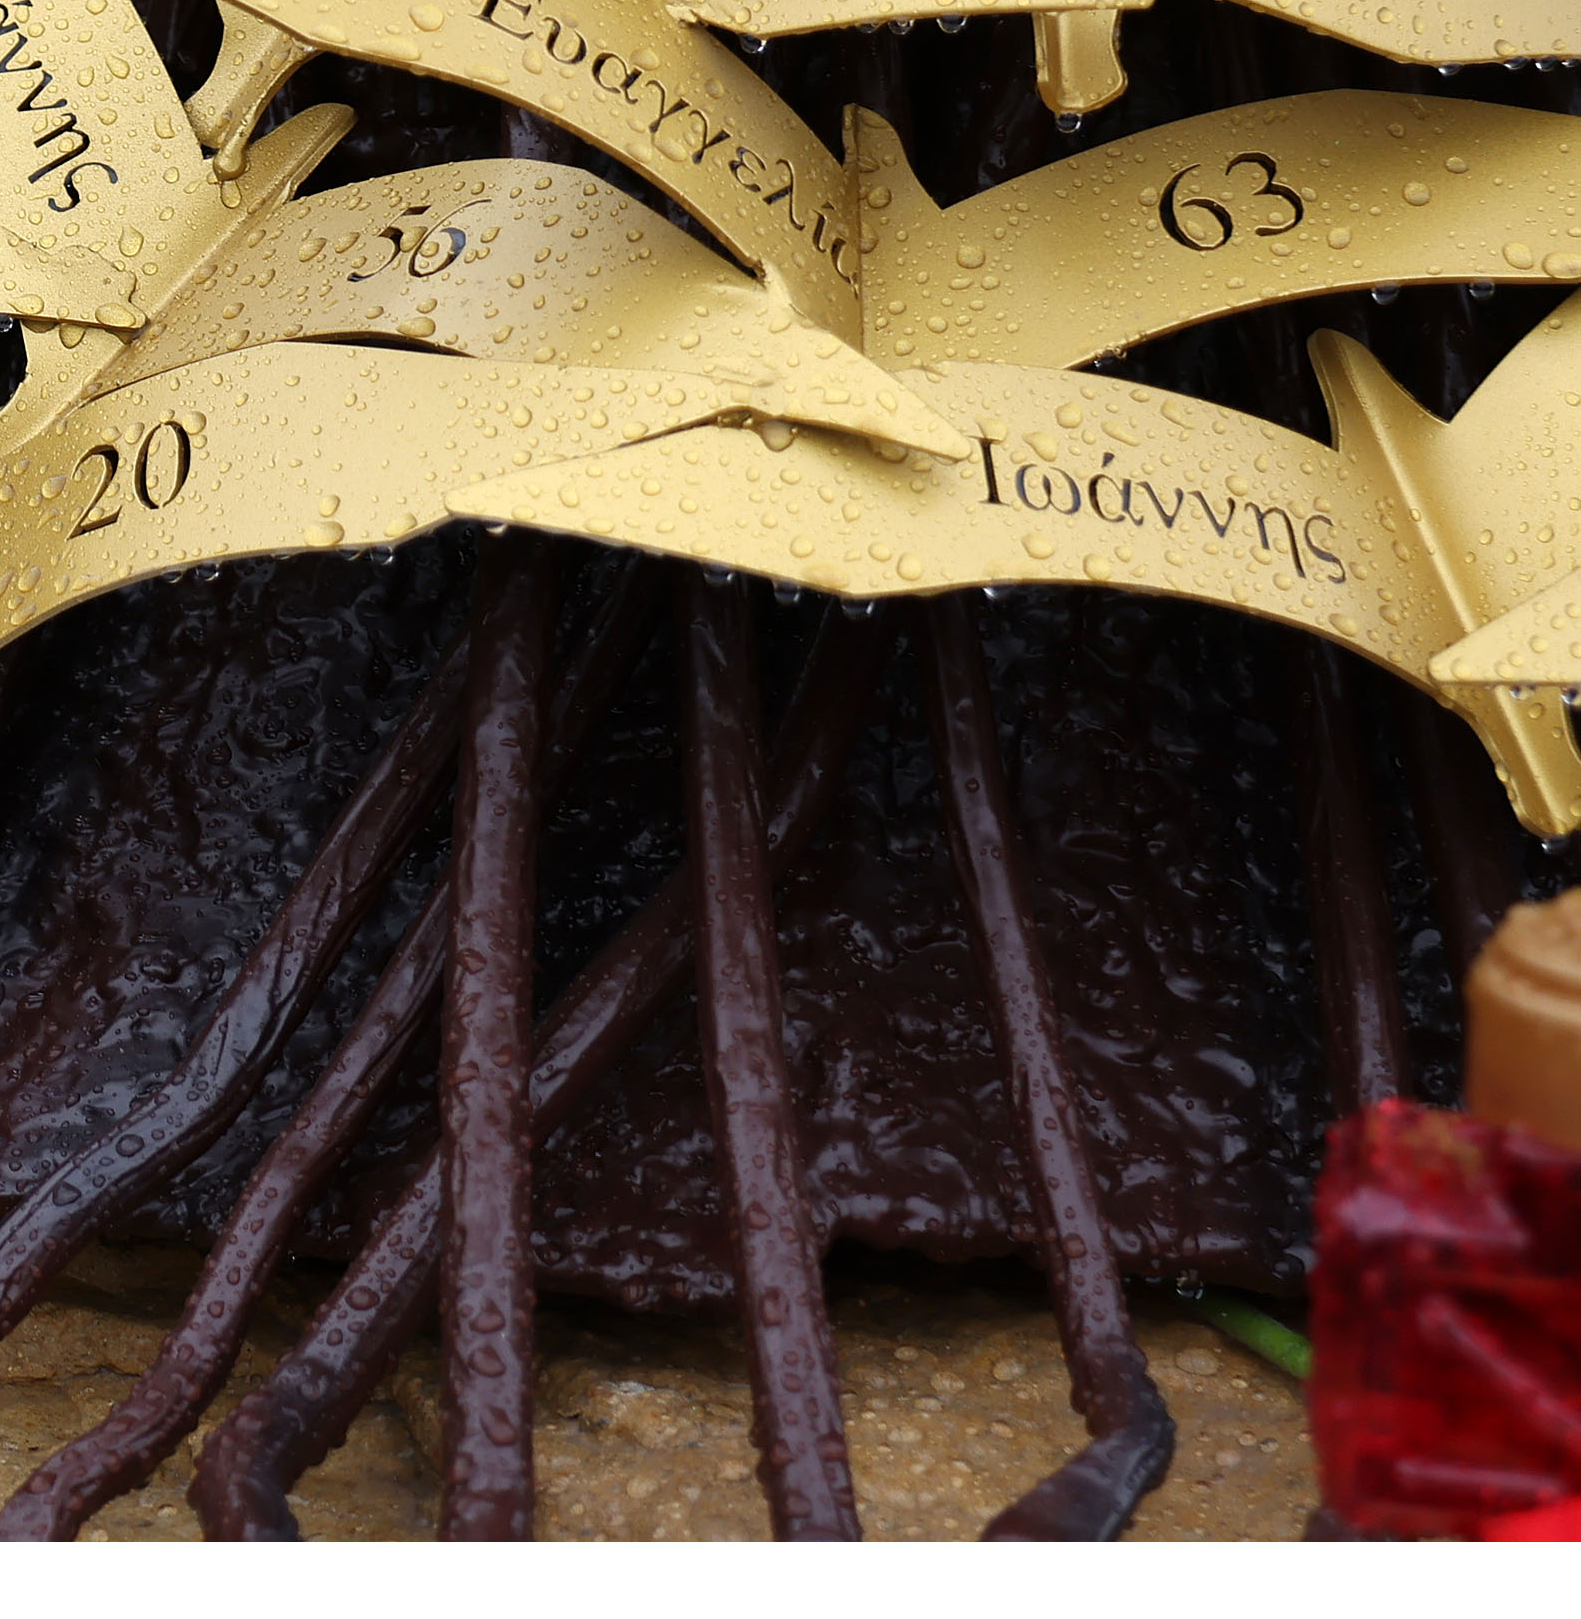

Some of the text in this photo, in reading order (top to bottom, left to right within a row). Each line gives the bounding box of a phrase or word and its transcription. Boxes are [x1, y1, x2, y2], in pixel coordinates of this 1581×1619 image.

[347, 199, 493, 282] 56
[1158, 151, 1304, 251] 63
[66, 420, 192, 541] 20
[971, 435, 1347, 584] Ιωάννης
